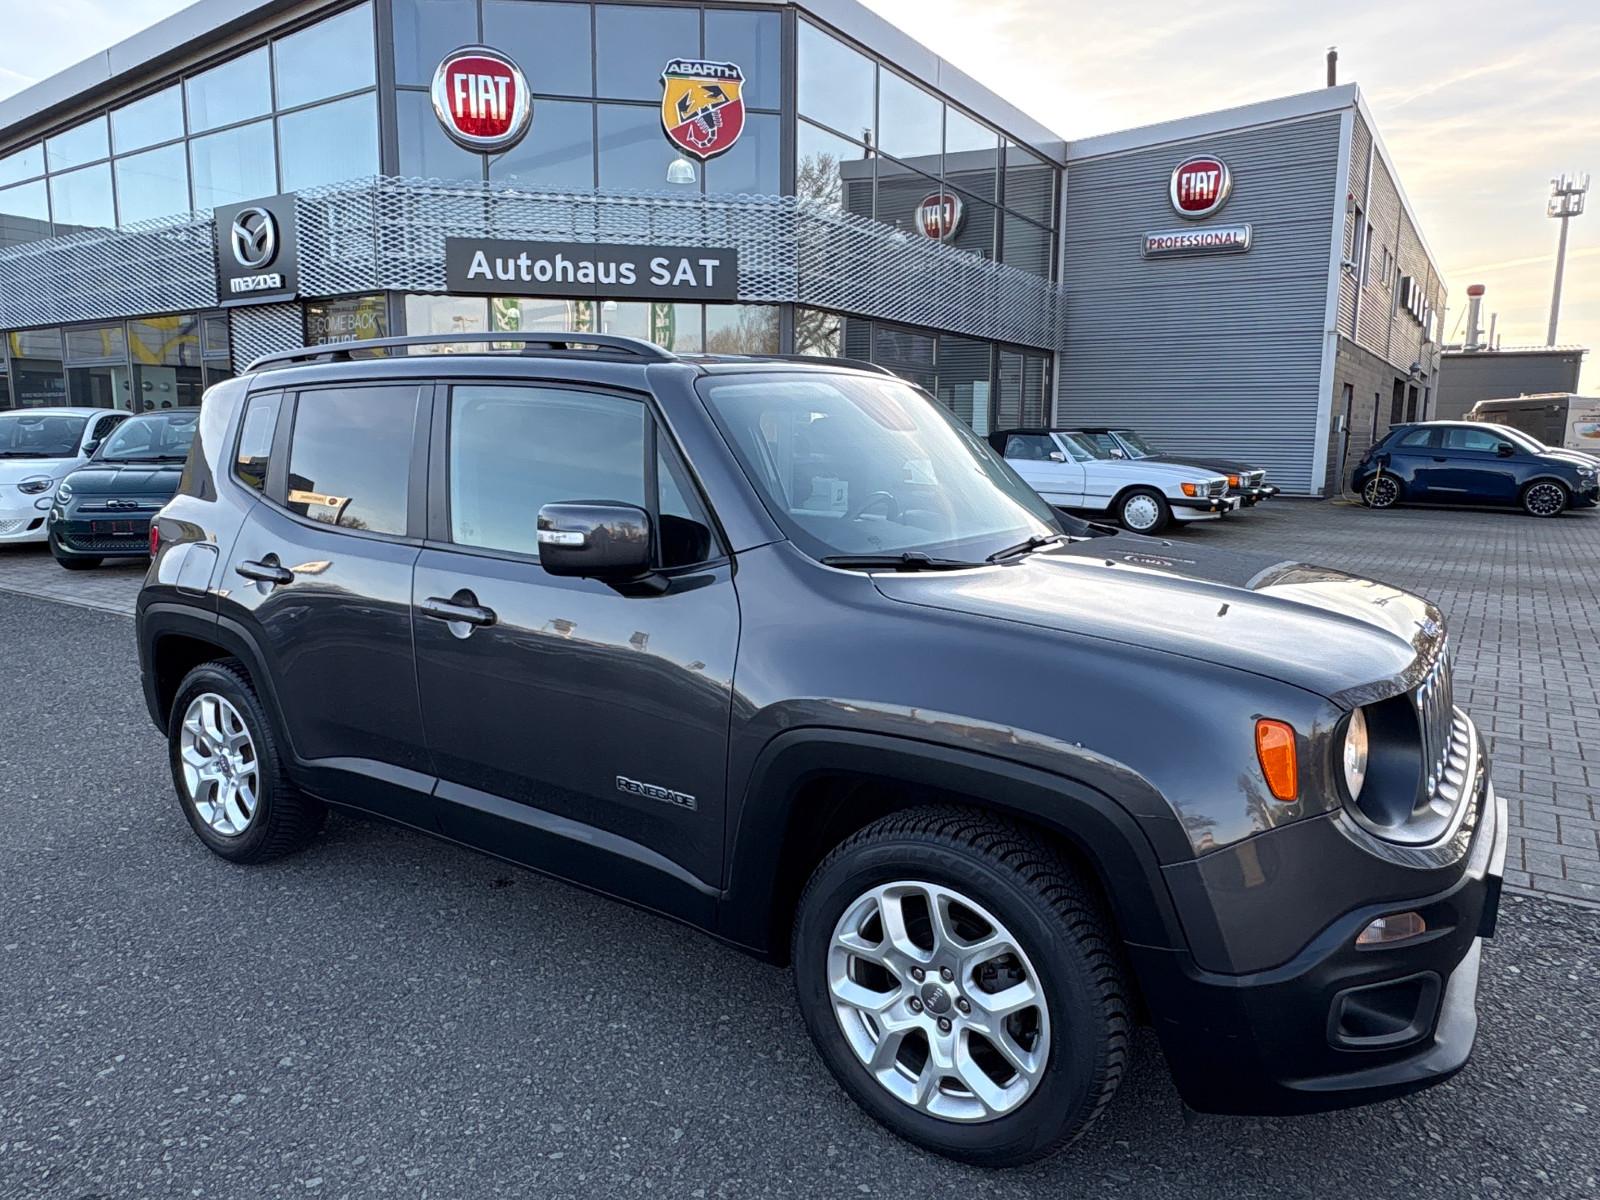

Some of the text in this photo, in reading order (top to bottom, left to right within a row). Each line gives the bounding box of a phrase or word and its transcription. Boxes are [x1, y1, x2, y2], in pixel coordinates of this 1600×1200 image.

[667, 63, 738, 78] ABARTH
[453, 72, 510, 120] FIAT
[1181, 170, 1218, 201] FIAT
[1149, 231, 1239, 250] PROFESSIONAL
[467, 250, 720, 287] Autohaus SAT
[317, 313, 377, 333] COME BACK
[616, 775, 697, 812] RENEGADE
